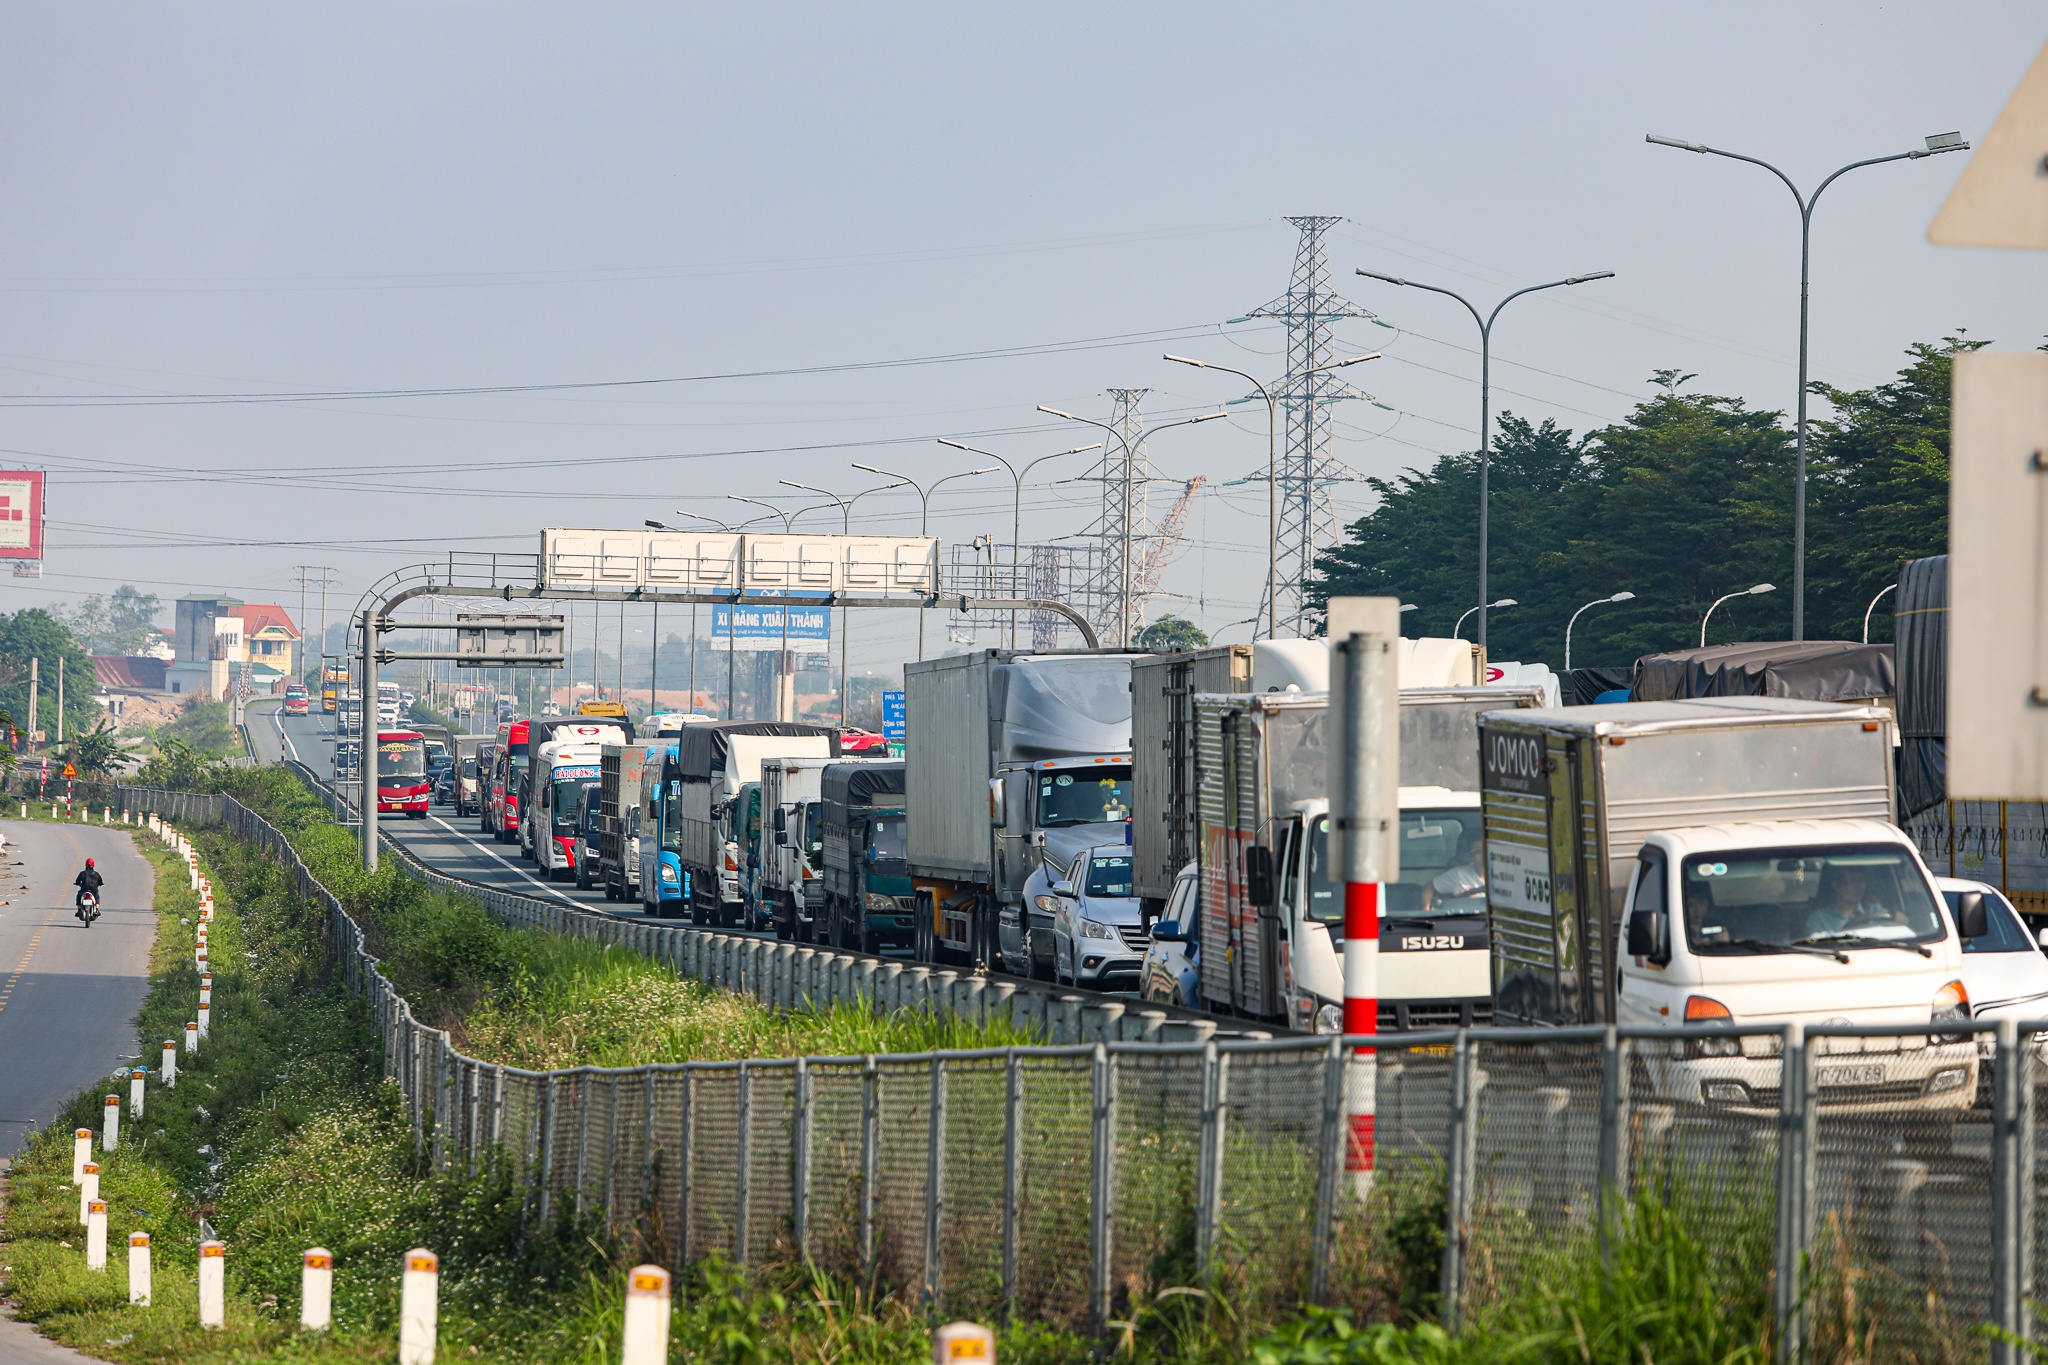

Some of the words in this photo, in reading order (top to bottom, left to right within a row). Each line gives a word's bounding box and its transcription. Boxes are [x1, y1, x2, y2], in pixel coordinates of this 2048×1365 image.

[717, 612, 727, 626] XI
[791, 611, 823, 628] THÀNH
[1489, 735, 1539, 778] JOMOO
[1402, 935, 1464, 950] ISUZU
